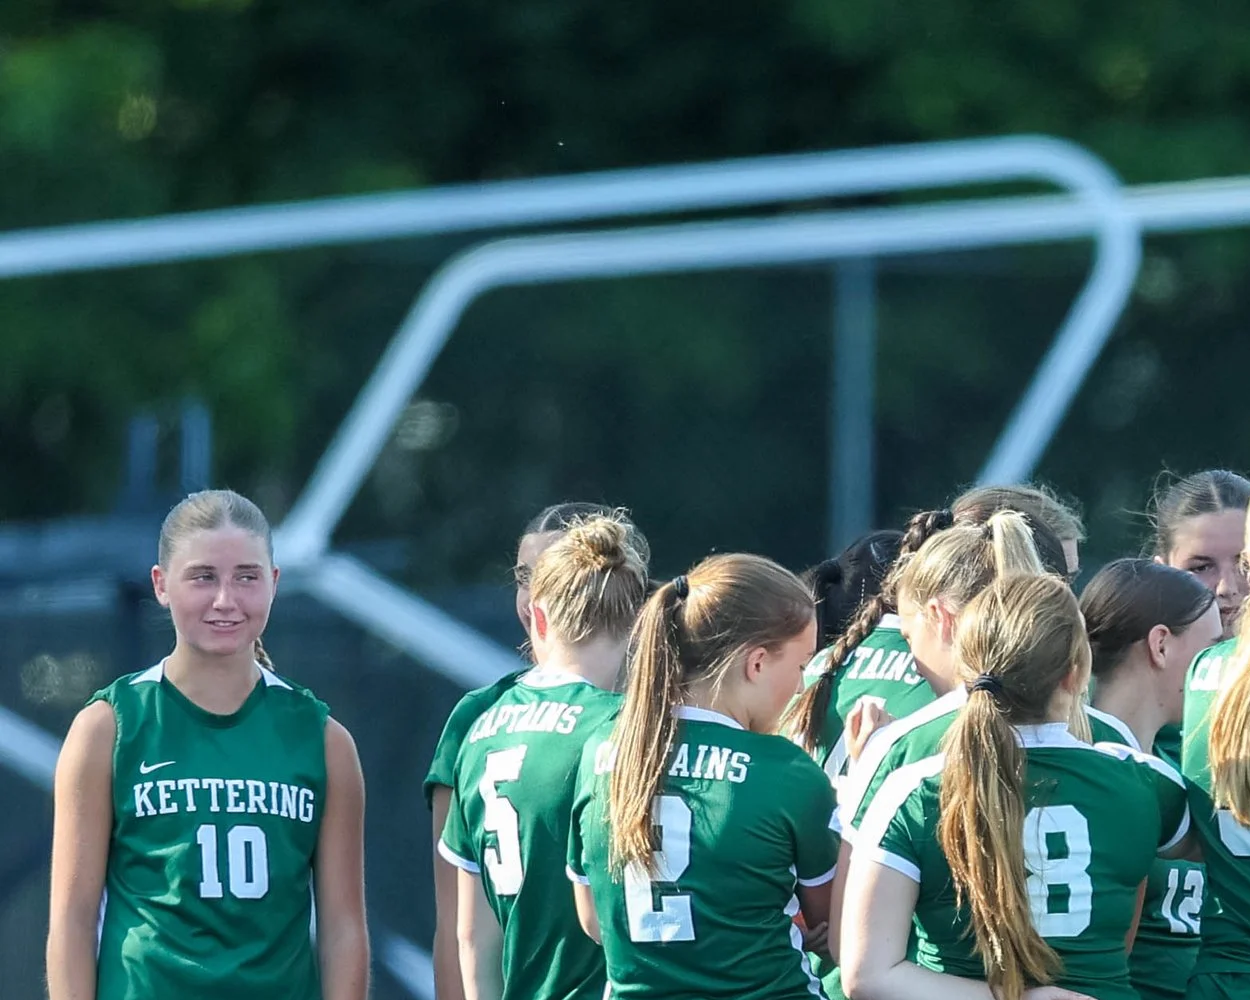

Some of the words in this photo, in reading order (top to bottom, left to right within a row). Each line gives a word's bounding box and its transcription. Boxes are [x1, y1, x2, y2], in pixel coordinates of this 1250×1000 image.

[469, 701, 583, 743] CAPTAINS
[133, 778, 315, 823] KETTERING
[479, 744, 528, 895] 5
[196, 824, 269, 899] 10
[624, 795, 695, 942] 2
[1022, 804, 1093, 937] 8
[1161, 868, 1204, 934] 12
